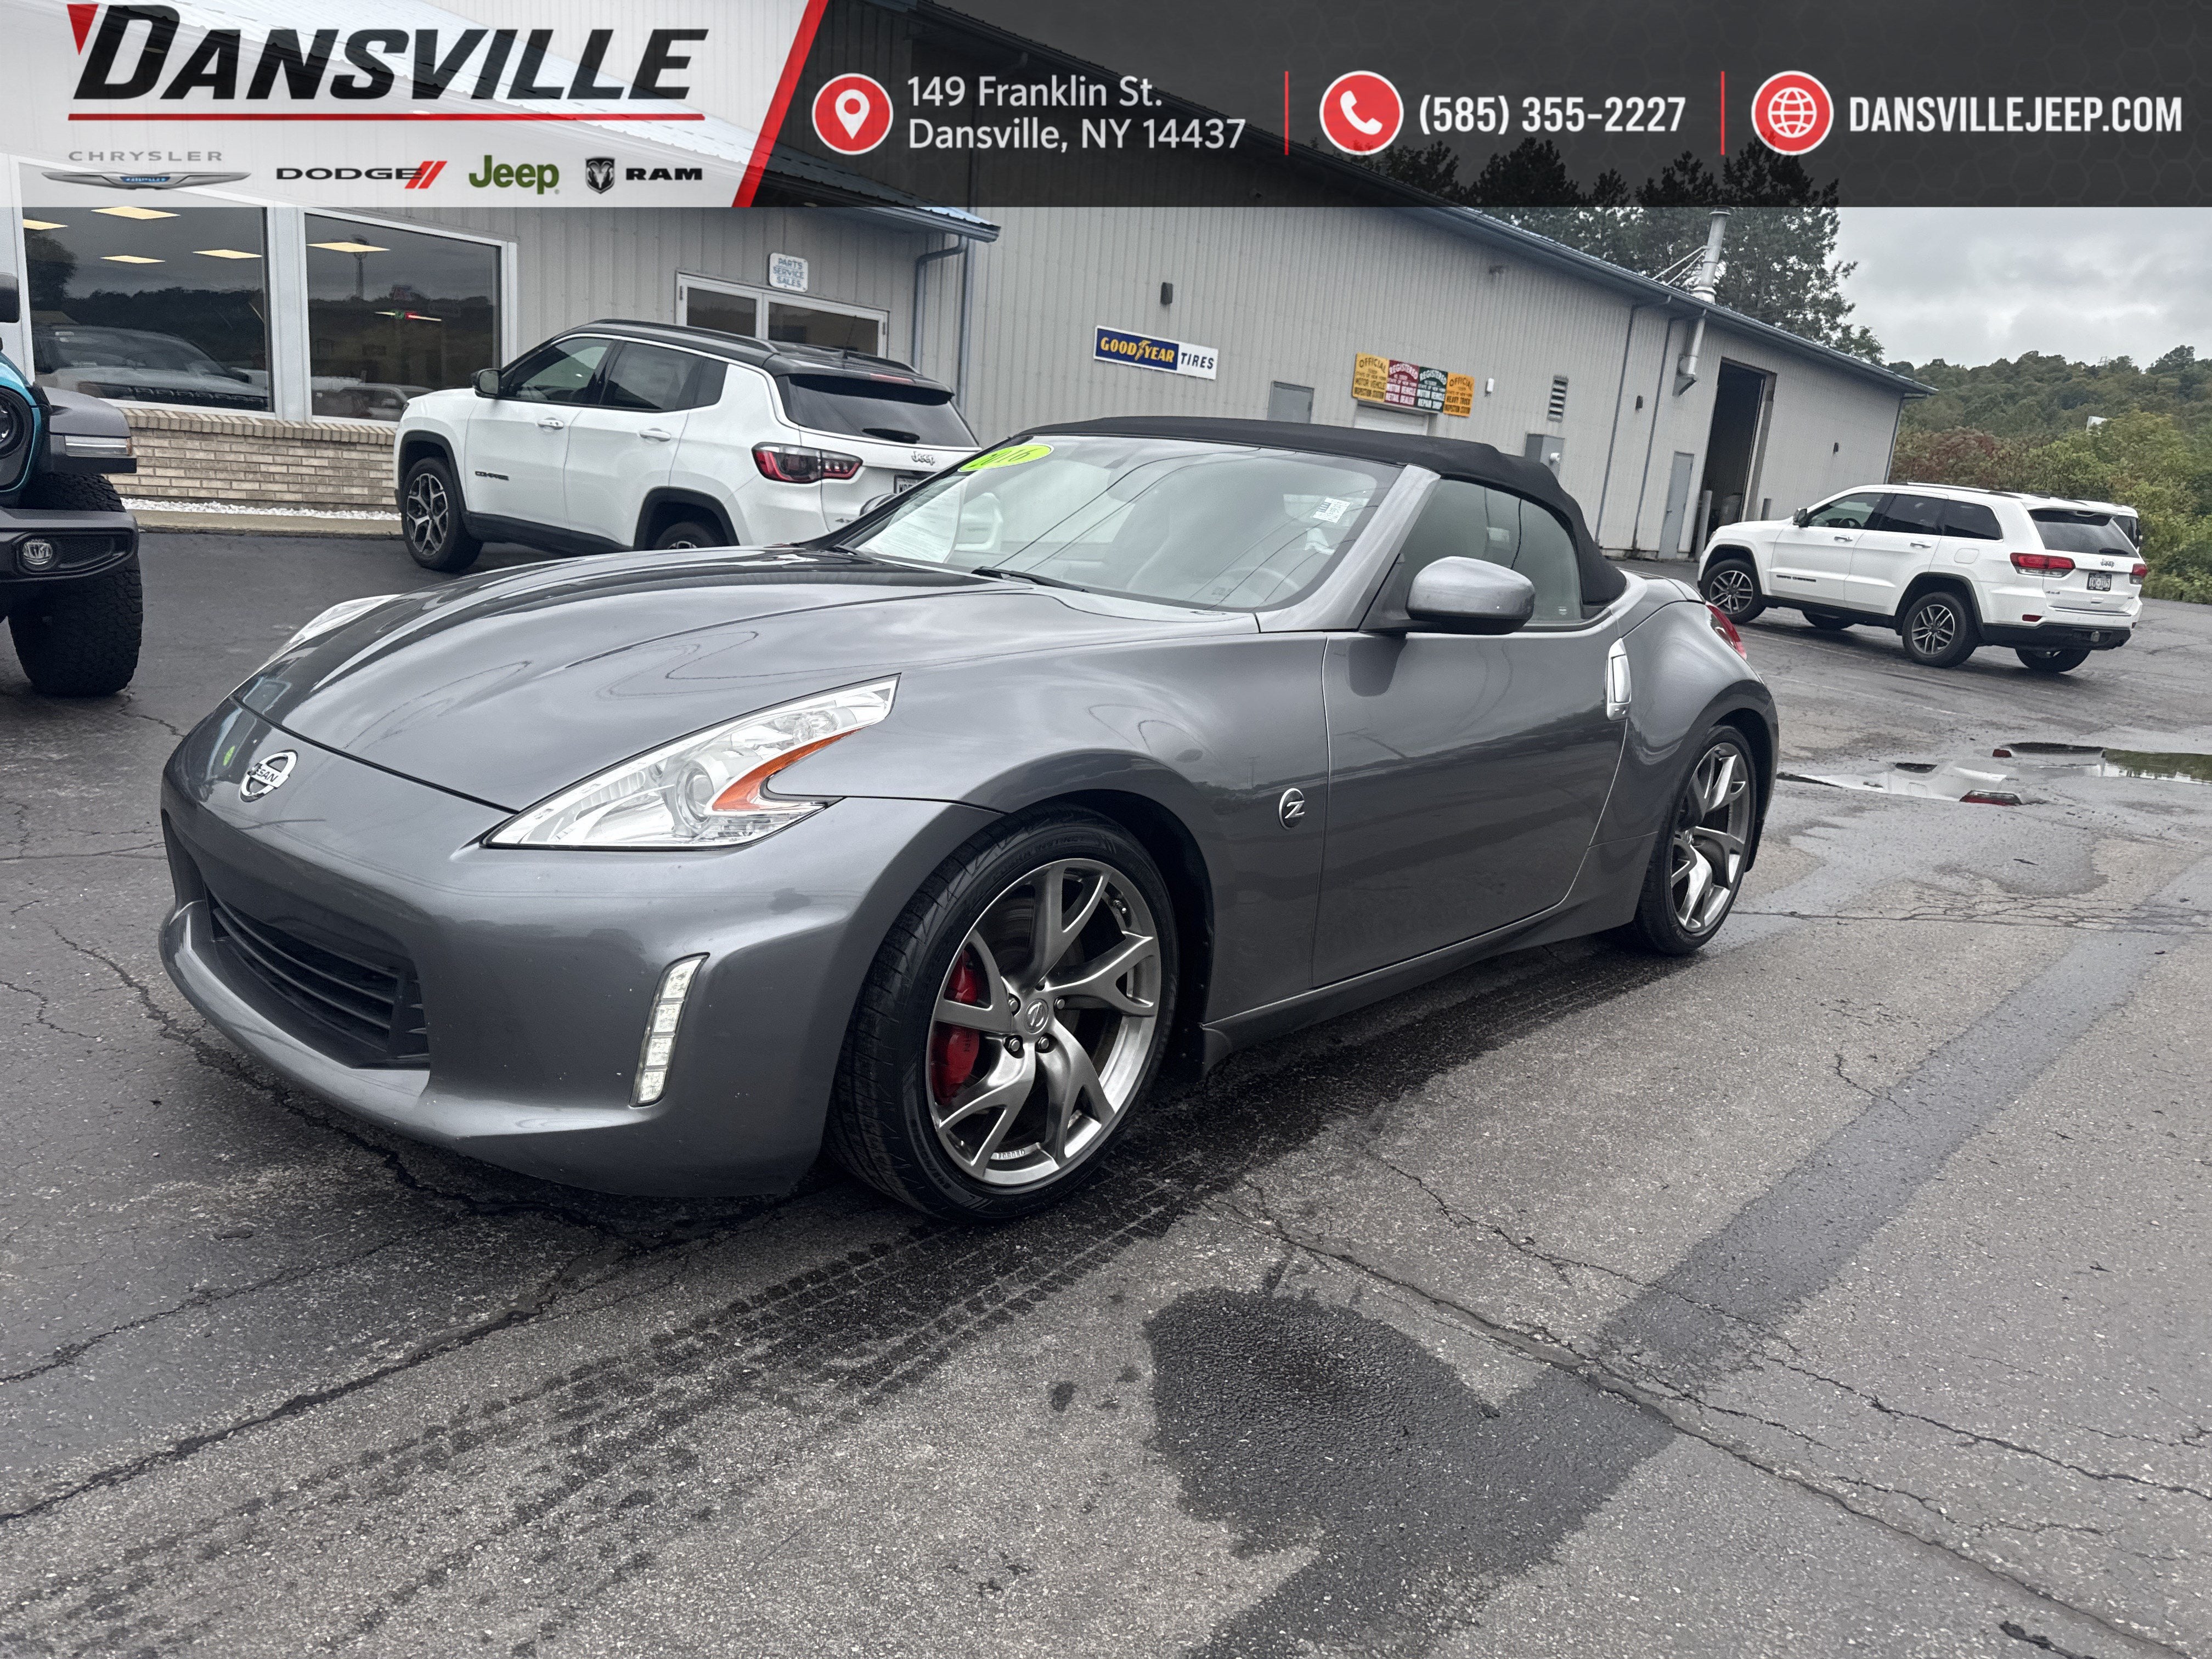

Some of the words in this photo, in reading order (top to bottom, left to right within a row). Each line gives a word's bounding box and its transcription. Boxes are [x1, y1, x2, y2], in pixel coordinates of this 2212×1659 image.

[778, 258, 803, 269] PARTS
[773, 266, 804, 279] SERVICE
[777, 275, 801, 287] SALES
[1100, 337, 1175, 363] GOODYEAR
[1181, 352, 1214, 370] TIRES
[1359, 357, 1386, 373] OFFICIAL
[1389, 363, 1418, 380] REGISTERED
[1419, 370, 1447, 385] REGISTERED
[911, 451, 935, 466] Jeep
[2100, 558, 2114, 568] Jeep
